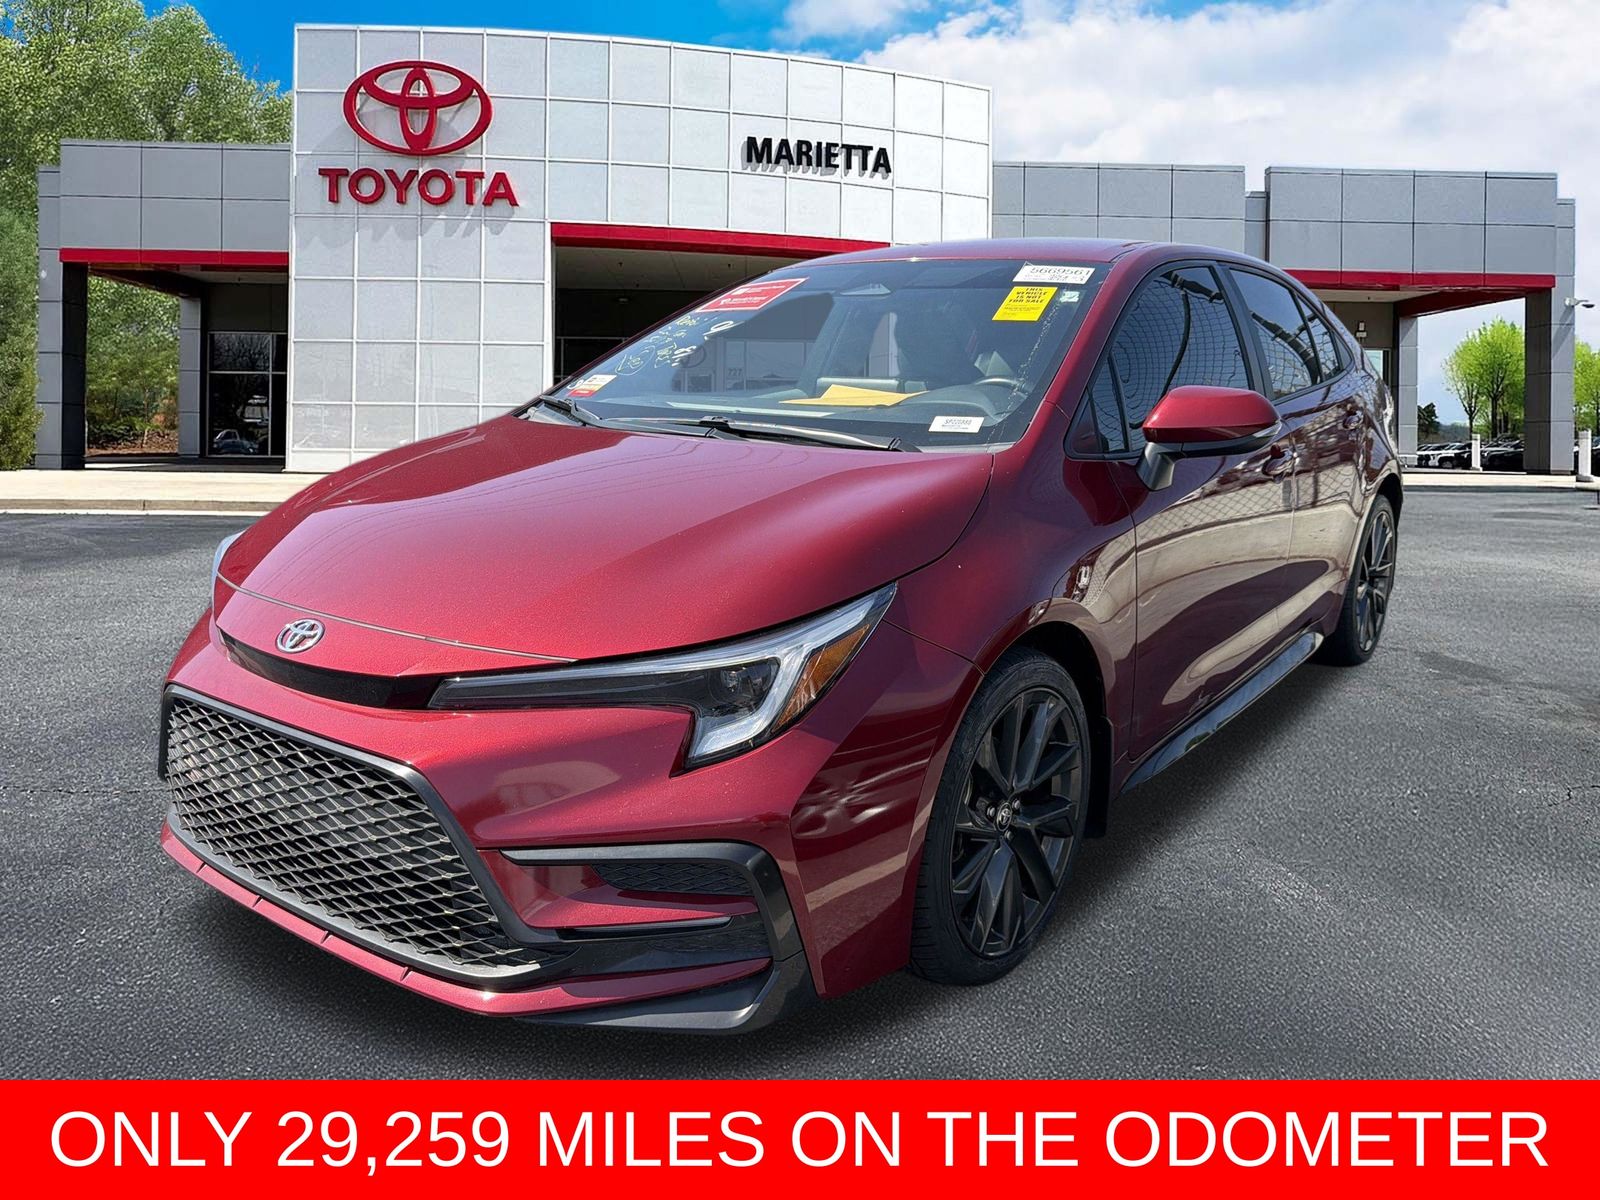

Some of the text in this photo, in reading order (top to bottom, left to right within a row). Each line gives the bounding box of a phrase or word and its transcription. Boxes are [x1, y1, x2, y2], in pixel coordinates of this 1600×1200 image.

[746, 136, 892, 173] MARIETTA
[318, 168, 520, 207] TOYOTA
[1030, 267, 1090, 276] 5669561
